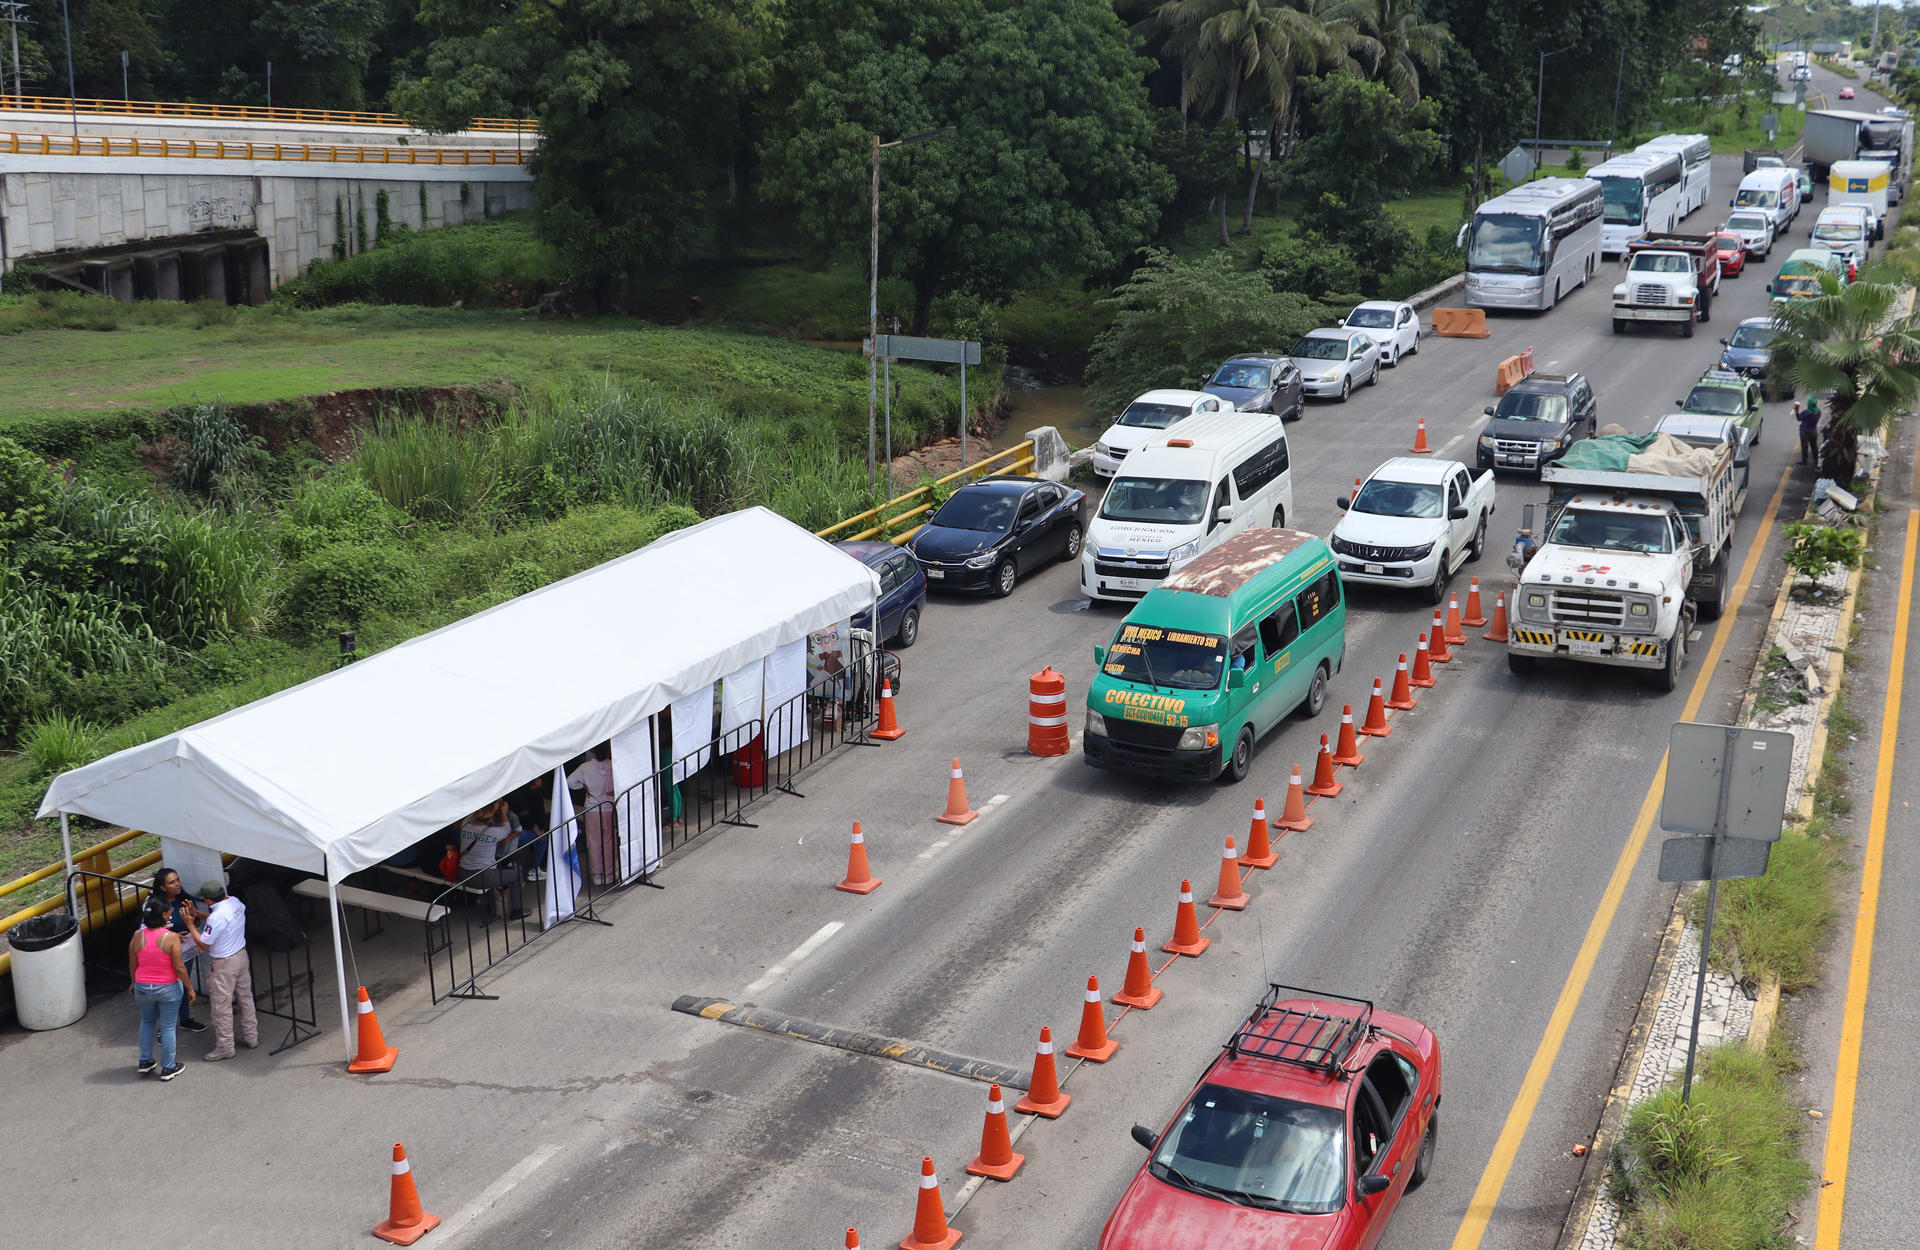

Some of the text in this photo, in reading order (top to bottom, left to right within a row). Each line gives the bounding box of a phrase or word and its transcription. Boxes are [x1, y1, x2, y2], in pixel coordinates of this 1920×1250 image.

[1123, 626, 1218, 649] VIVA MEXICO LIBRAMIENTO SUR
[1110, 644, 1141, 656] DERECHA
[1105, 689, 1186, 713] COLECTIVO
[1166, 713, 1189, 728] 53-15
